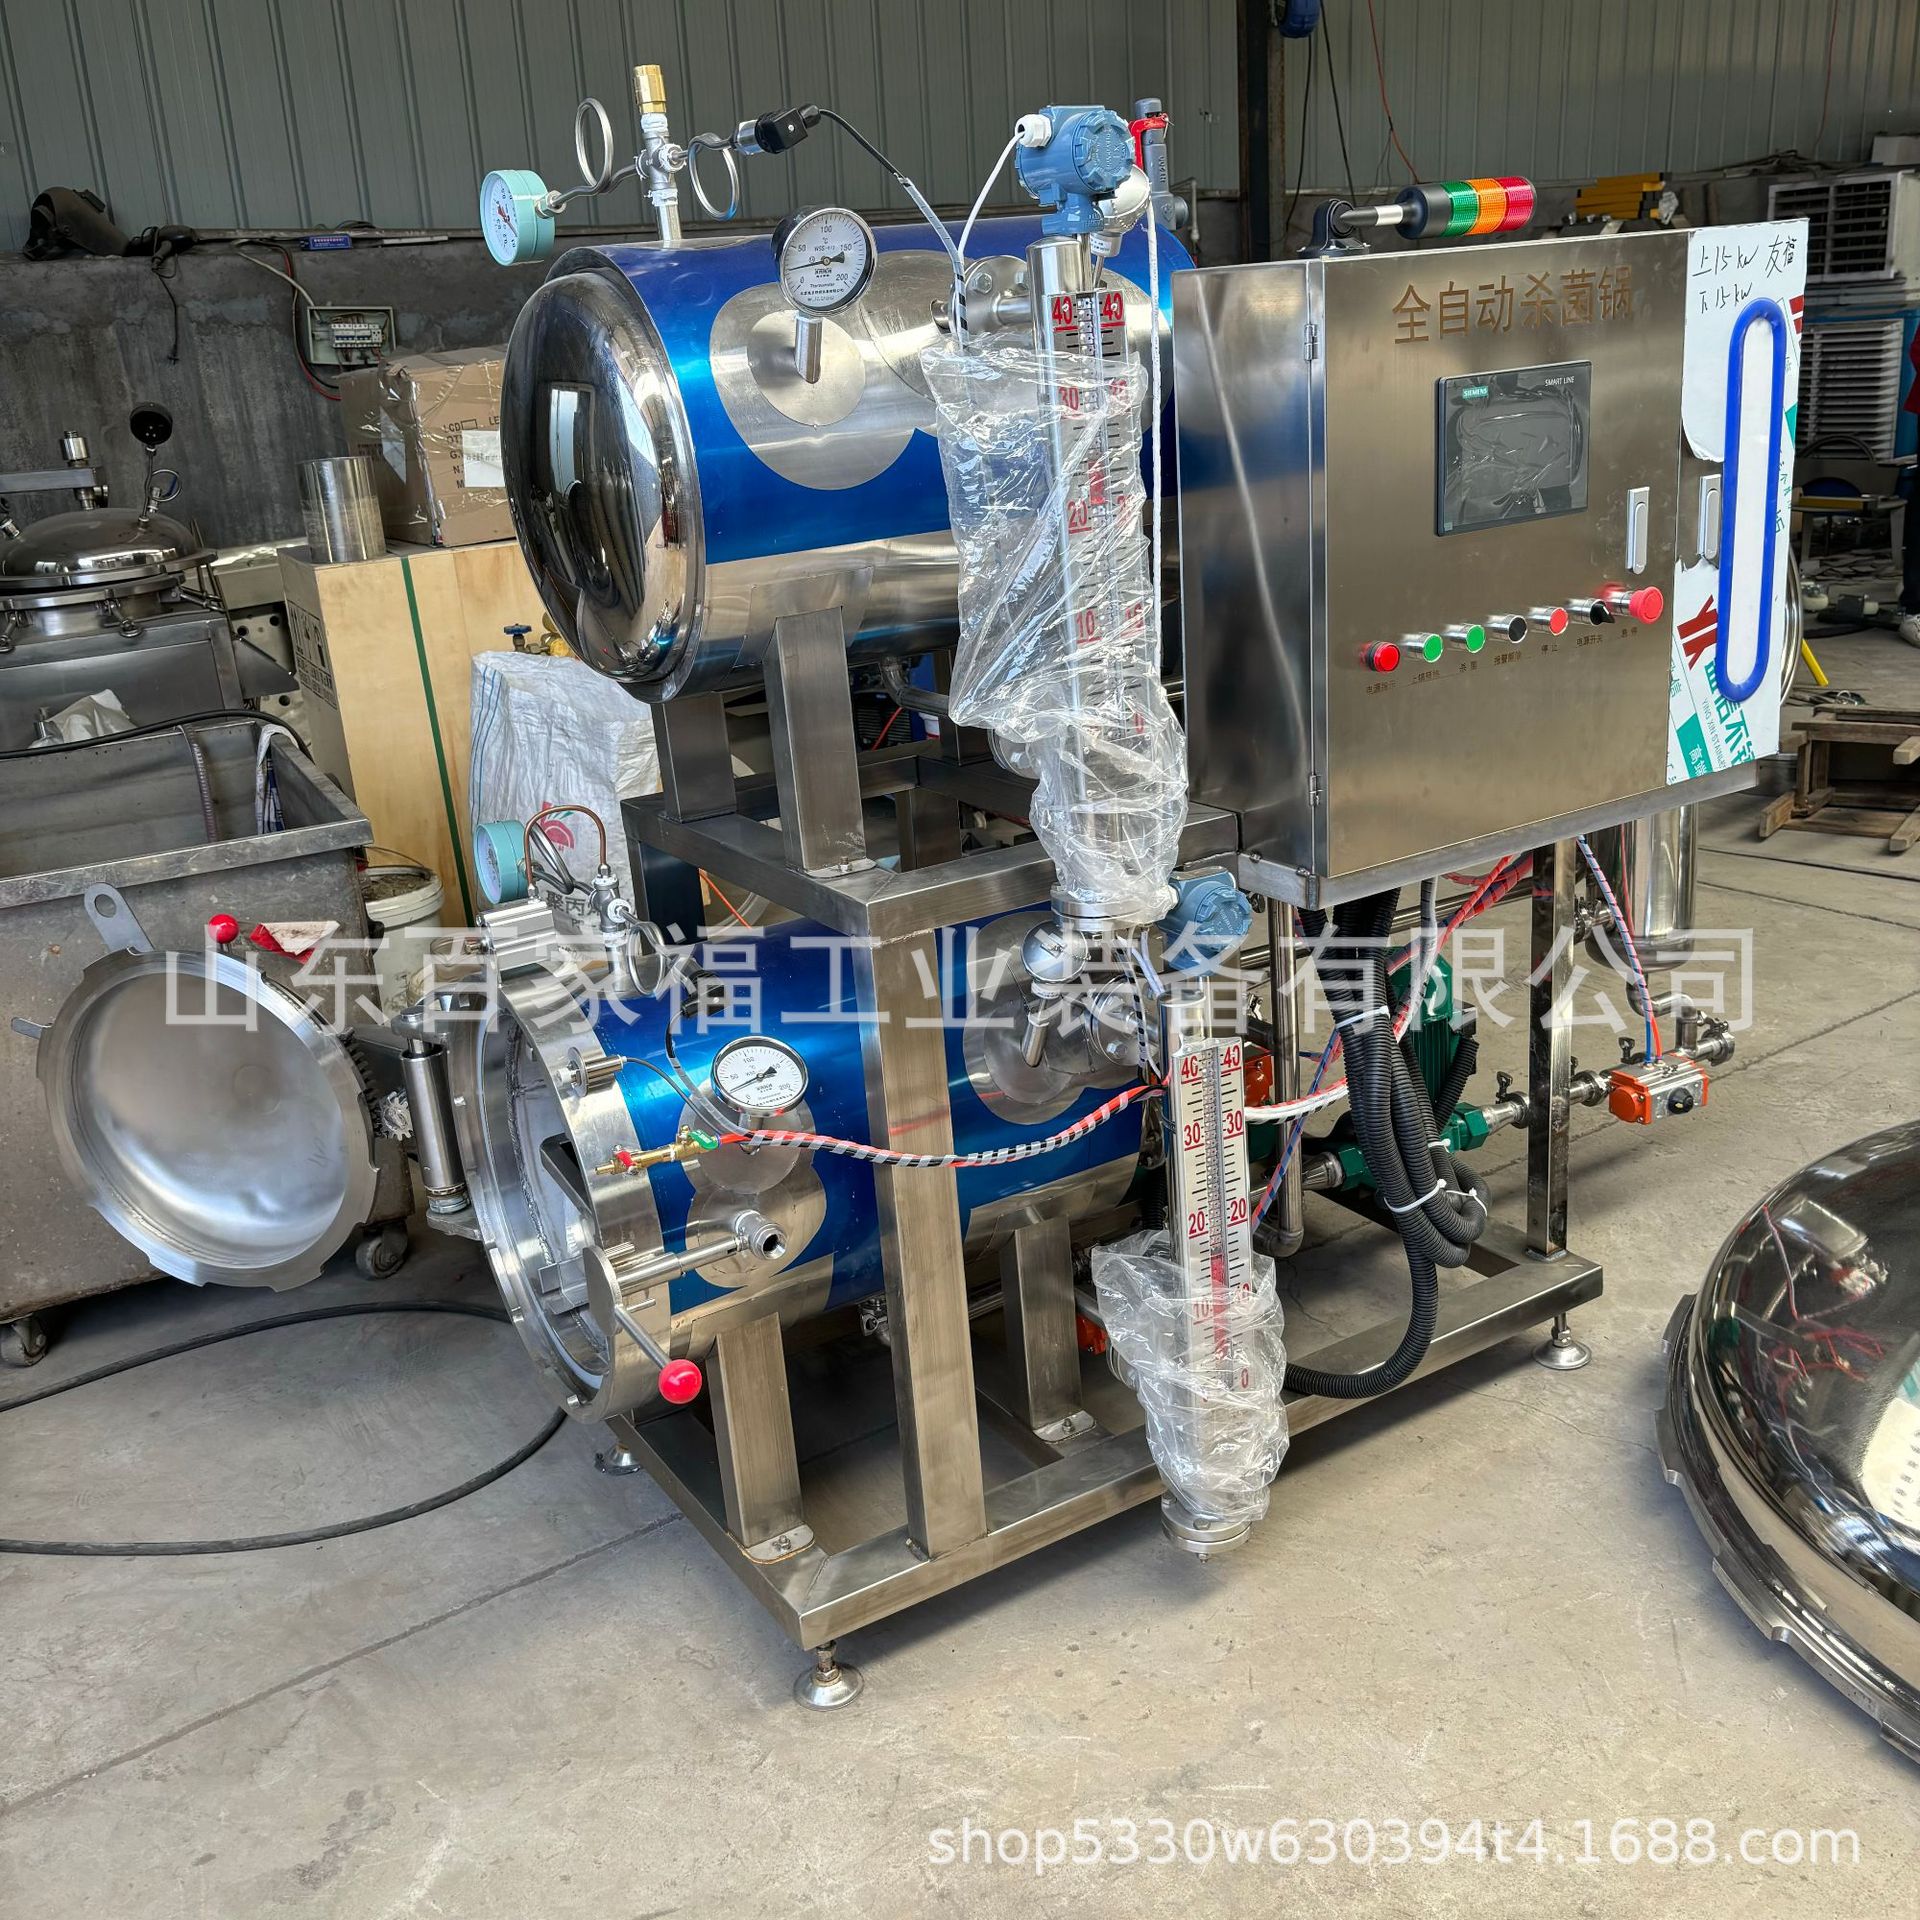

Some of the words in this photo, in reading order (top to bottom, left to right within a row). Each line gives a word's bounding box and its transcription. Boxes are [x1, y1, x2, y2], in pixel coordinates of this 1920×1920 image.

[820, 225, 832, 233] 100
[797, 244, 807, 252] 50
[840, 243, 852, 252] 150
[835, 273, 849, 281] 200
[1051, 295, 1073, 325] 40
[1102, 292, 1124, 321] 40
[1391, 264, 1633, 345] 全自动杀菌锅
[1463, 387, 1489, 398] SIEMENS
[1545, 378, 1563, 387] SMART
[1563, 376, 1576, 384] LINE
[1067, 502, 1089, 529] 20
[1075, 610, 1096, 637] 10
[1181, 1055, 1199, 1079] 40
[1222, 1044, 1241, 1068] 40
[1183, 1121, 1202, 1147] 30
[1226, 1110, 1244, 1135] 30
[1230, 1197, 1248, 1222] 20
[1188, 1210, 1206, 1236] 20
